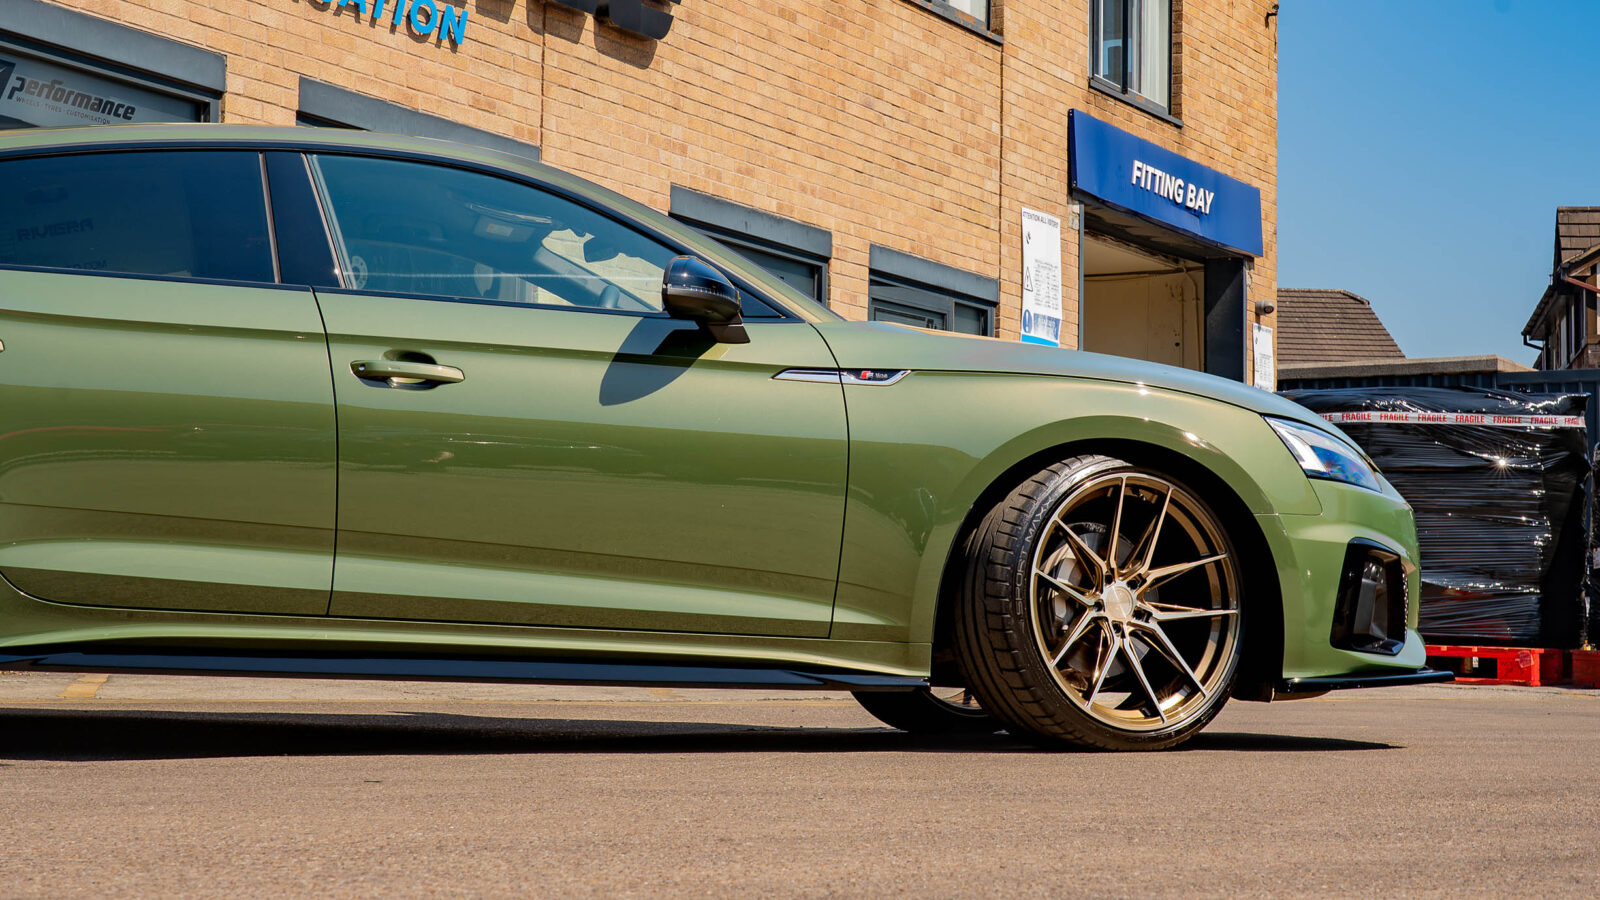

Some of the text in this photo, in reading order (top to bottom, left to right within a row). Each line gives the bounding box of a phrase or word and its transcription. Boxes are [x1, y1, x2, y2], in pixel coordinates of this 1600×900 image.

[314, 0, 469, 45] TION
[1131, 160, 1214, 214] FITTING BAY
[1341, 412, 1371, 421] FRAGILE
[1379, 412, 1409, 421] FRAGILE
[1417, 413, 1447, 422] FRAGILE
[1455, 414, 1485, 423] FRAGILE
[1493, 415, 1522, 424] FRAGILE
[1530, 416, 1558, 425] FRAGILE
[1015, 497, 1053, 615] SPORT MAXX
